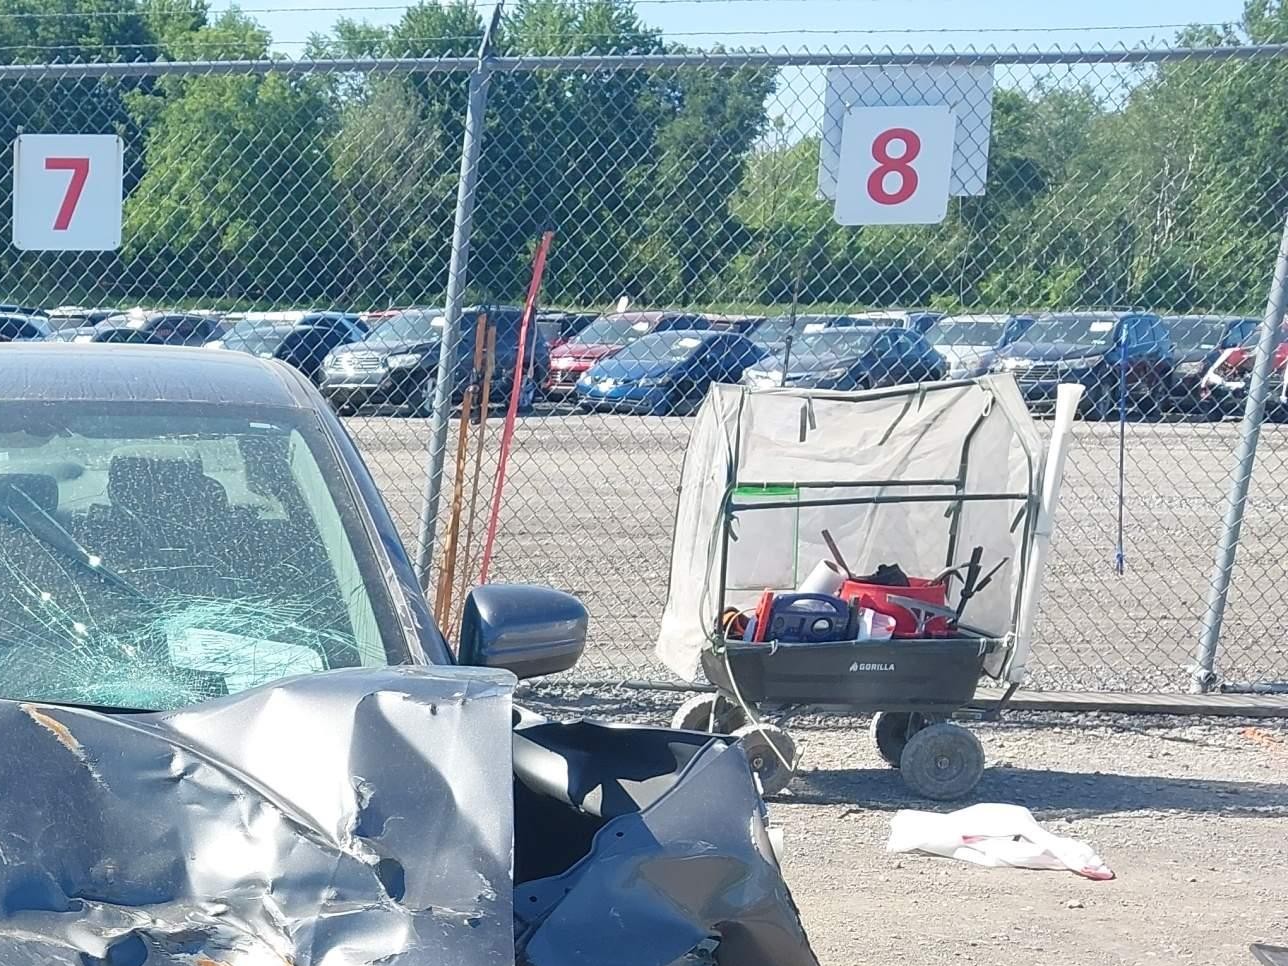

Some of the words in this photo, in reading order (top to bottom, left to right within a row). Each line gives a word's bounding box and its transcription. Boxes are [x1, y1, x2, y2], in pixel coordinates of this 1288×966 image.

[45, 158, 89, 230] 7
[868, 129, 920, 205] 8
[859, 662, 895, 671] GORILLA
